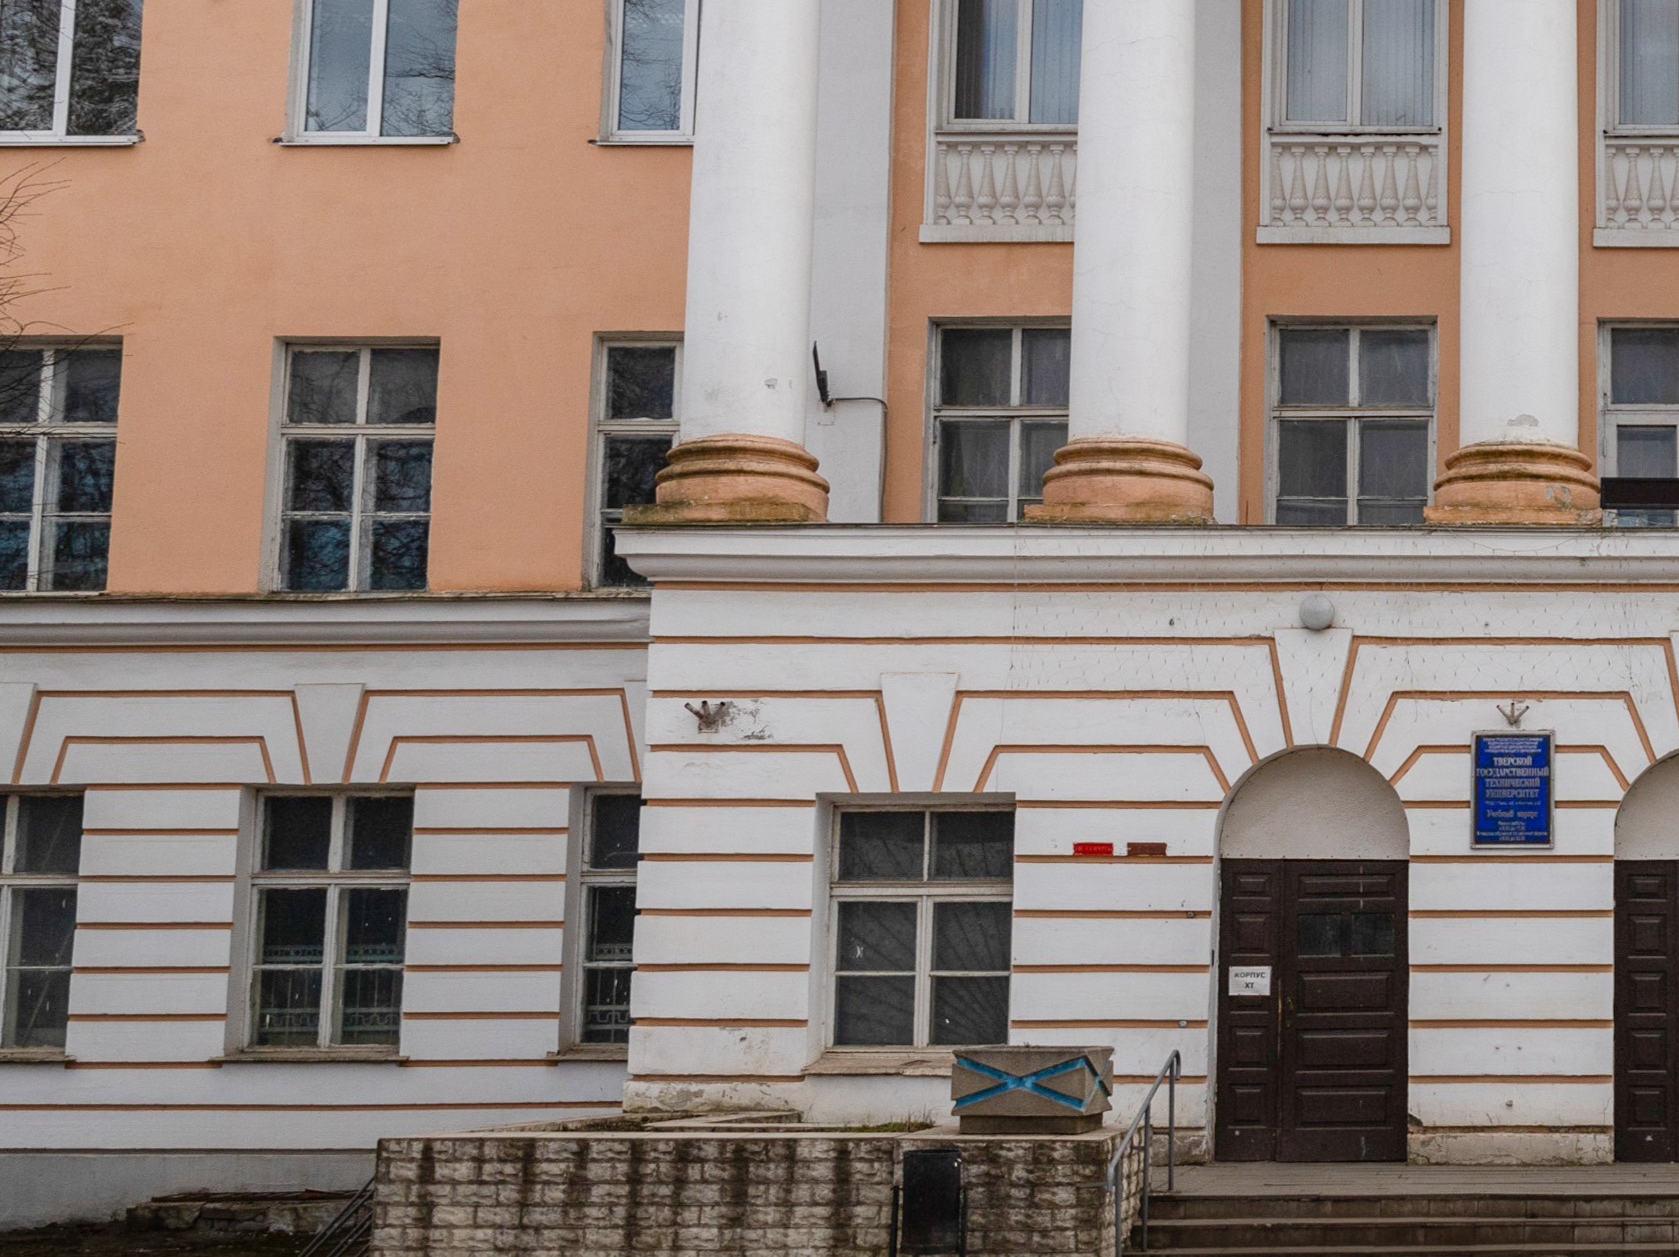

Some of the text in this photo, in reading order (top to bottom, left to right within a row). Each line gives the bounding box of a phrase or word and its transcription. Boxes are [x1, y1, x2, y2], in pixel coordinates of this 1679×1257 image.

[1493, 755, 1532, 766] ТВЕРСКОЙ
[1477, 766, 1549, 777] ГОСУДАРСТВЕННЫЙ
[1485, 777, 1540, 788] ТЕХНИЧЕСКИЙ
[1486, 789, 1539, 798] УНИВЕРСИТЕТ
